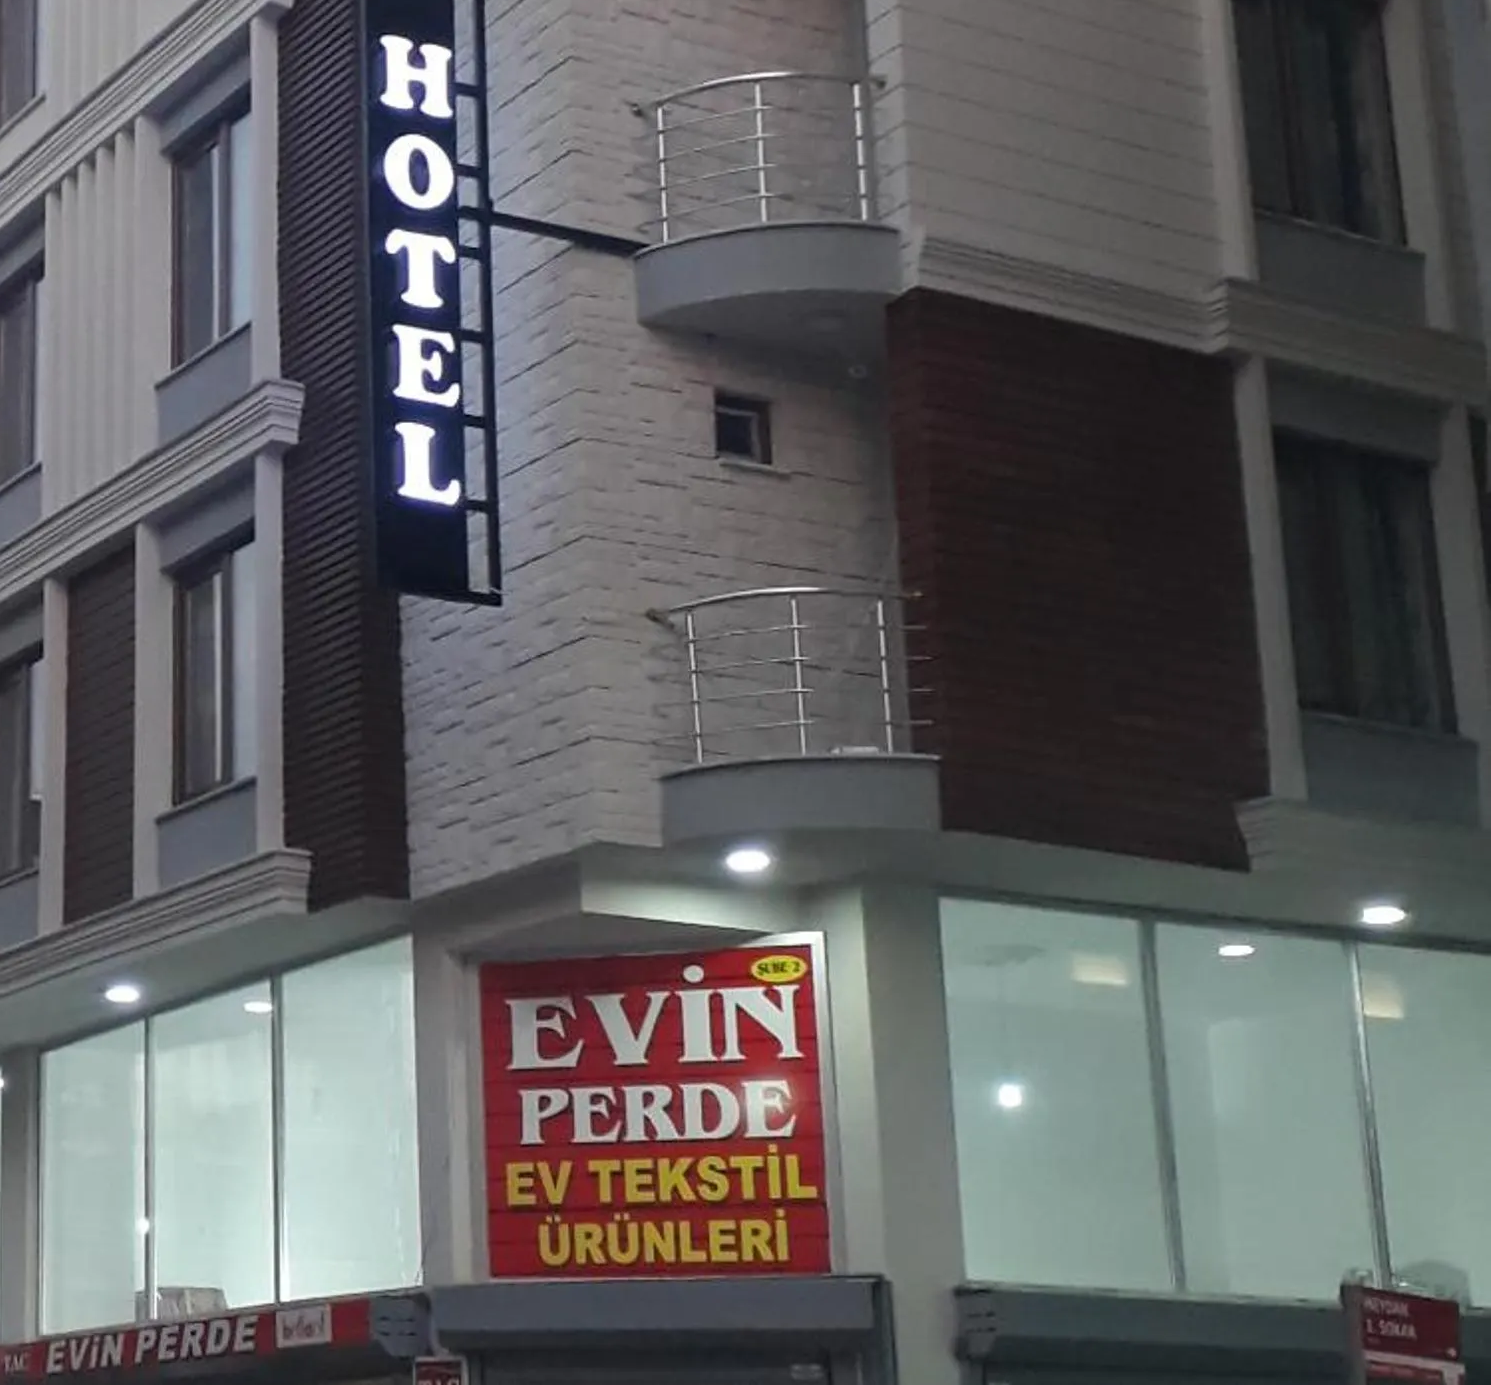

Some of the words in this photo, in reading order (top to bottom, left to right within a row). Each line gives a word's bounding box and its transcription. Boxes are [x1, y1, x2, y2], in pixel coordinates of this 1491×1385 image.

[380, 35, 461, 506] HOTEL
[505, 965, 805, 1070] EVİN
[519, 1080, 797, 1146] PERDE
[506, 1161, 572, 1206] EV
[588, 1143, 817, 1205] TEKSTİL
[538, 1209, 790, 1266] ÜRÜNLERİ
[134, 1315, 258, 1365] PERDE
